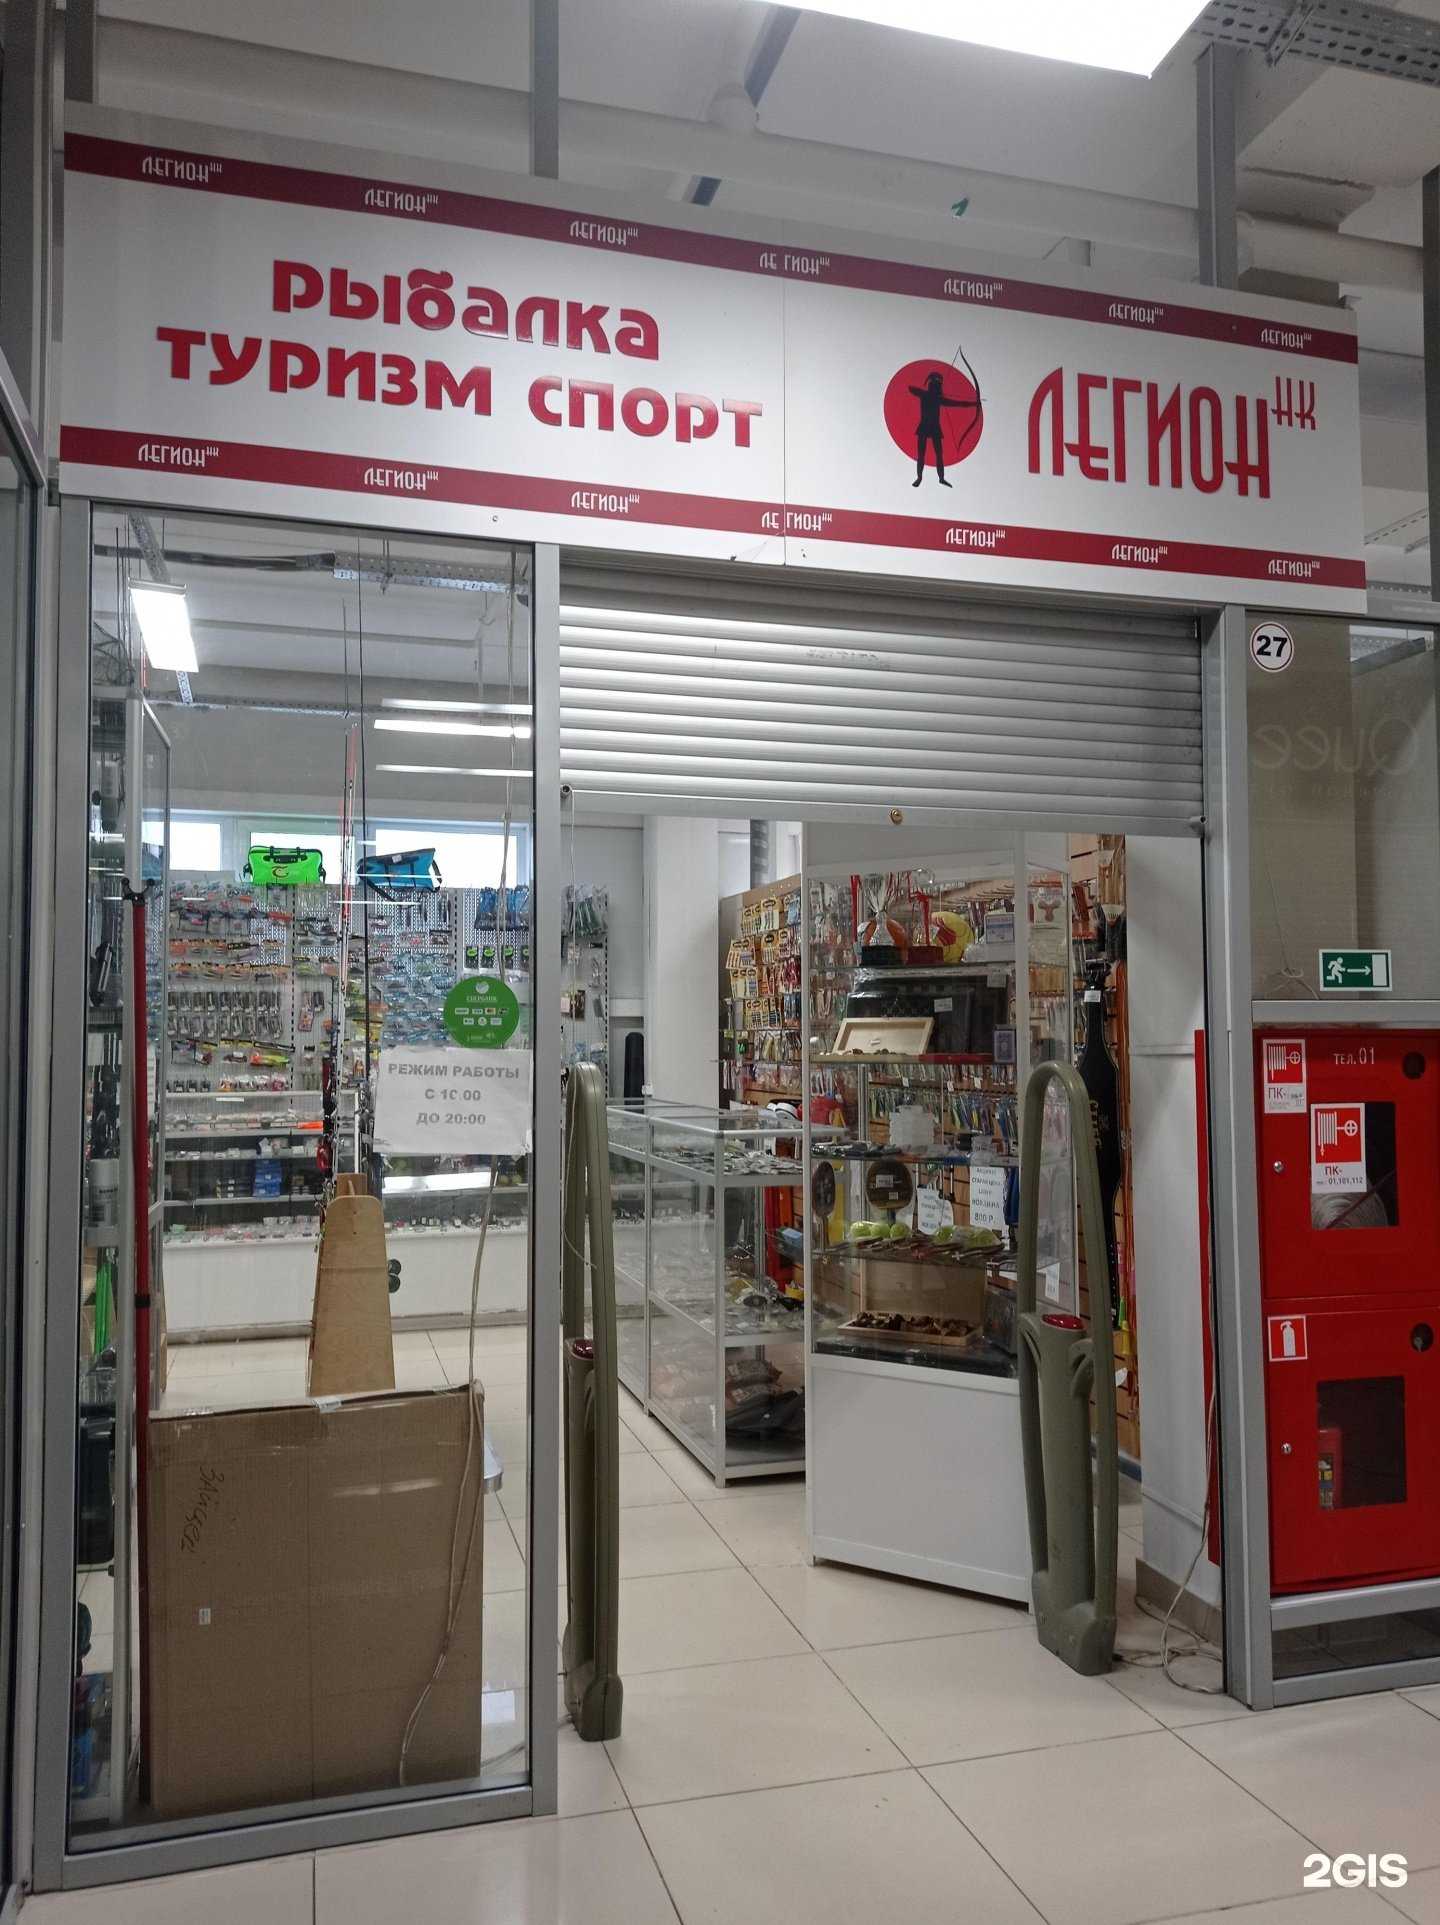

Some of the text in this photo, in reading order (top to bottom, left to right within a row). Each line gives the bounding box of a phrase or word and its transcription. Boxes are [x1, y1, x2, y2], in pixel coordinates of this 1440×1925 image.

[1256, 635, 1287, 657] 27
[388, 1062, 519, 1079] РЕЖИМ РАБОТЫ
[424, 1088, 435, 1100] С
[416, 1112, 486, 1126] ДО 20:00
